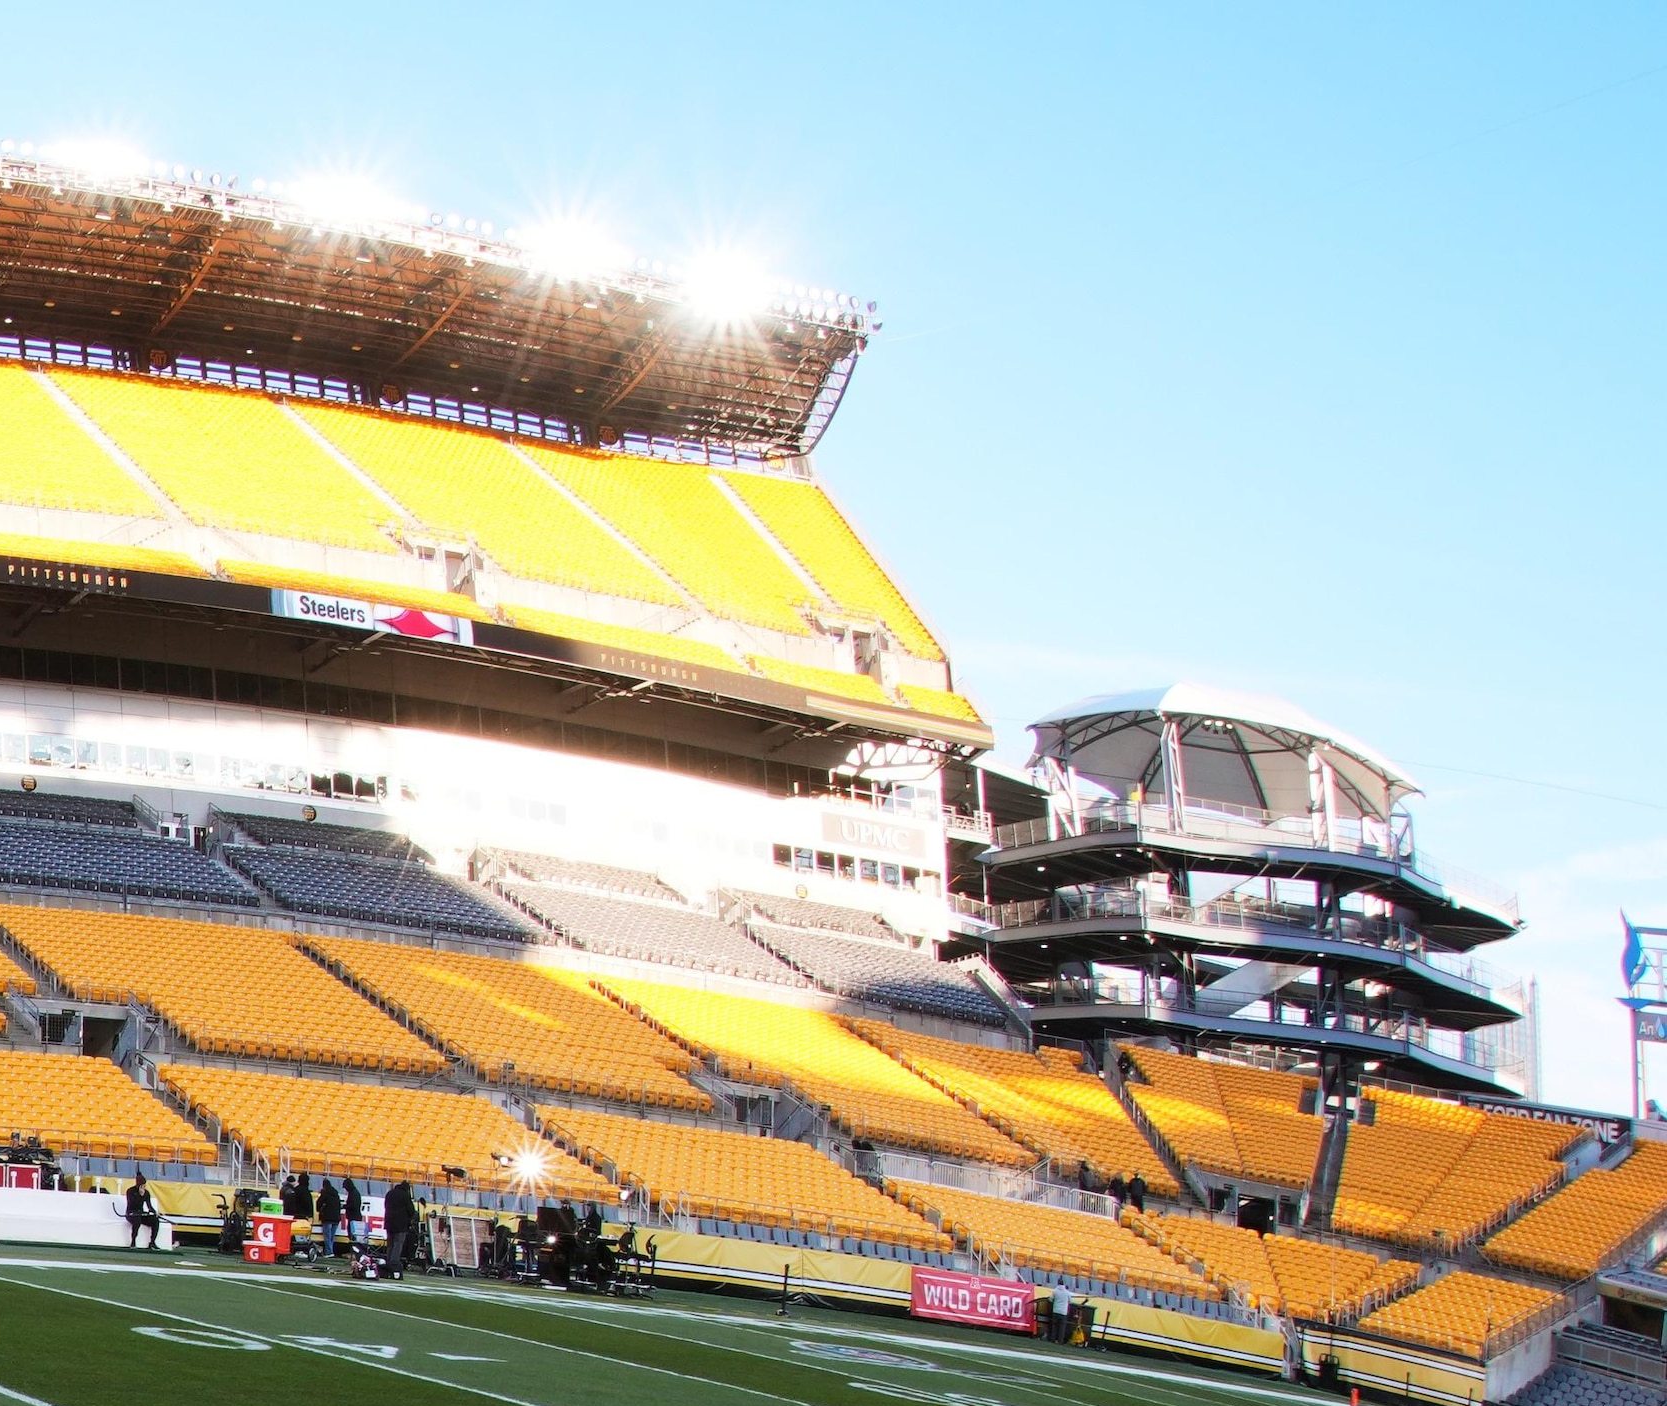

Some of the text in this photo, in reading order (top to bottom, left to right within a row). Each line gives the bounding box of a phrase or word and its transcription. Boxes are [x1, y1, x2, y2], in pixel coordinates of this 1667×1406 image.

[8, 564, 127, 588] PITTSBURGH
[300, 595, 365, 623] Steelers
[840, 819, 910, 850] UPMC
[257, 1222, 274, 1243] G
[249, 1248, 259, 1260] G
[923, 1284, 1023, 1319] WILD CARD
